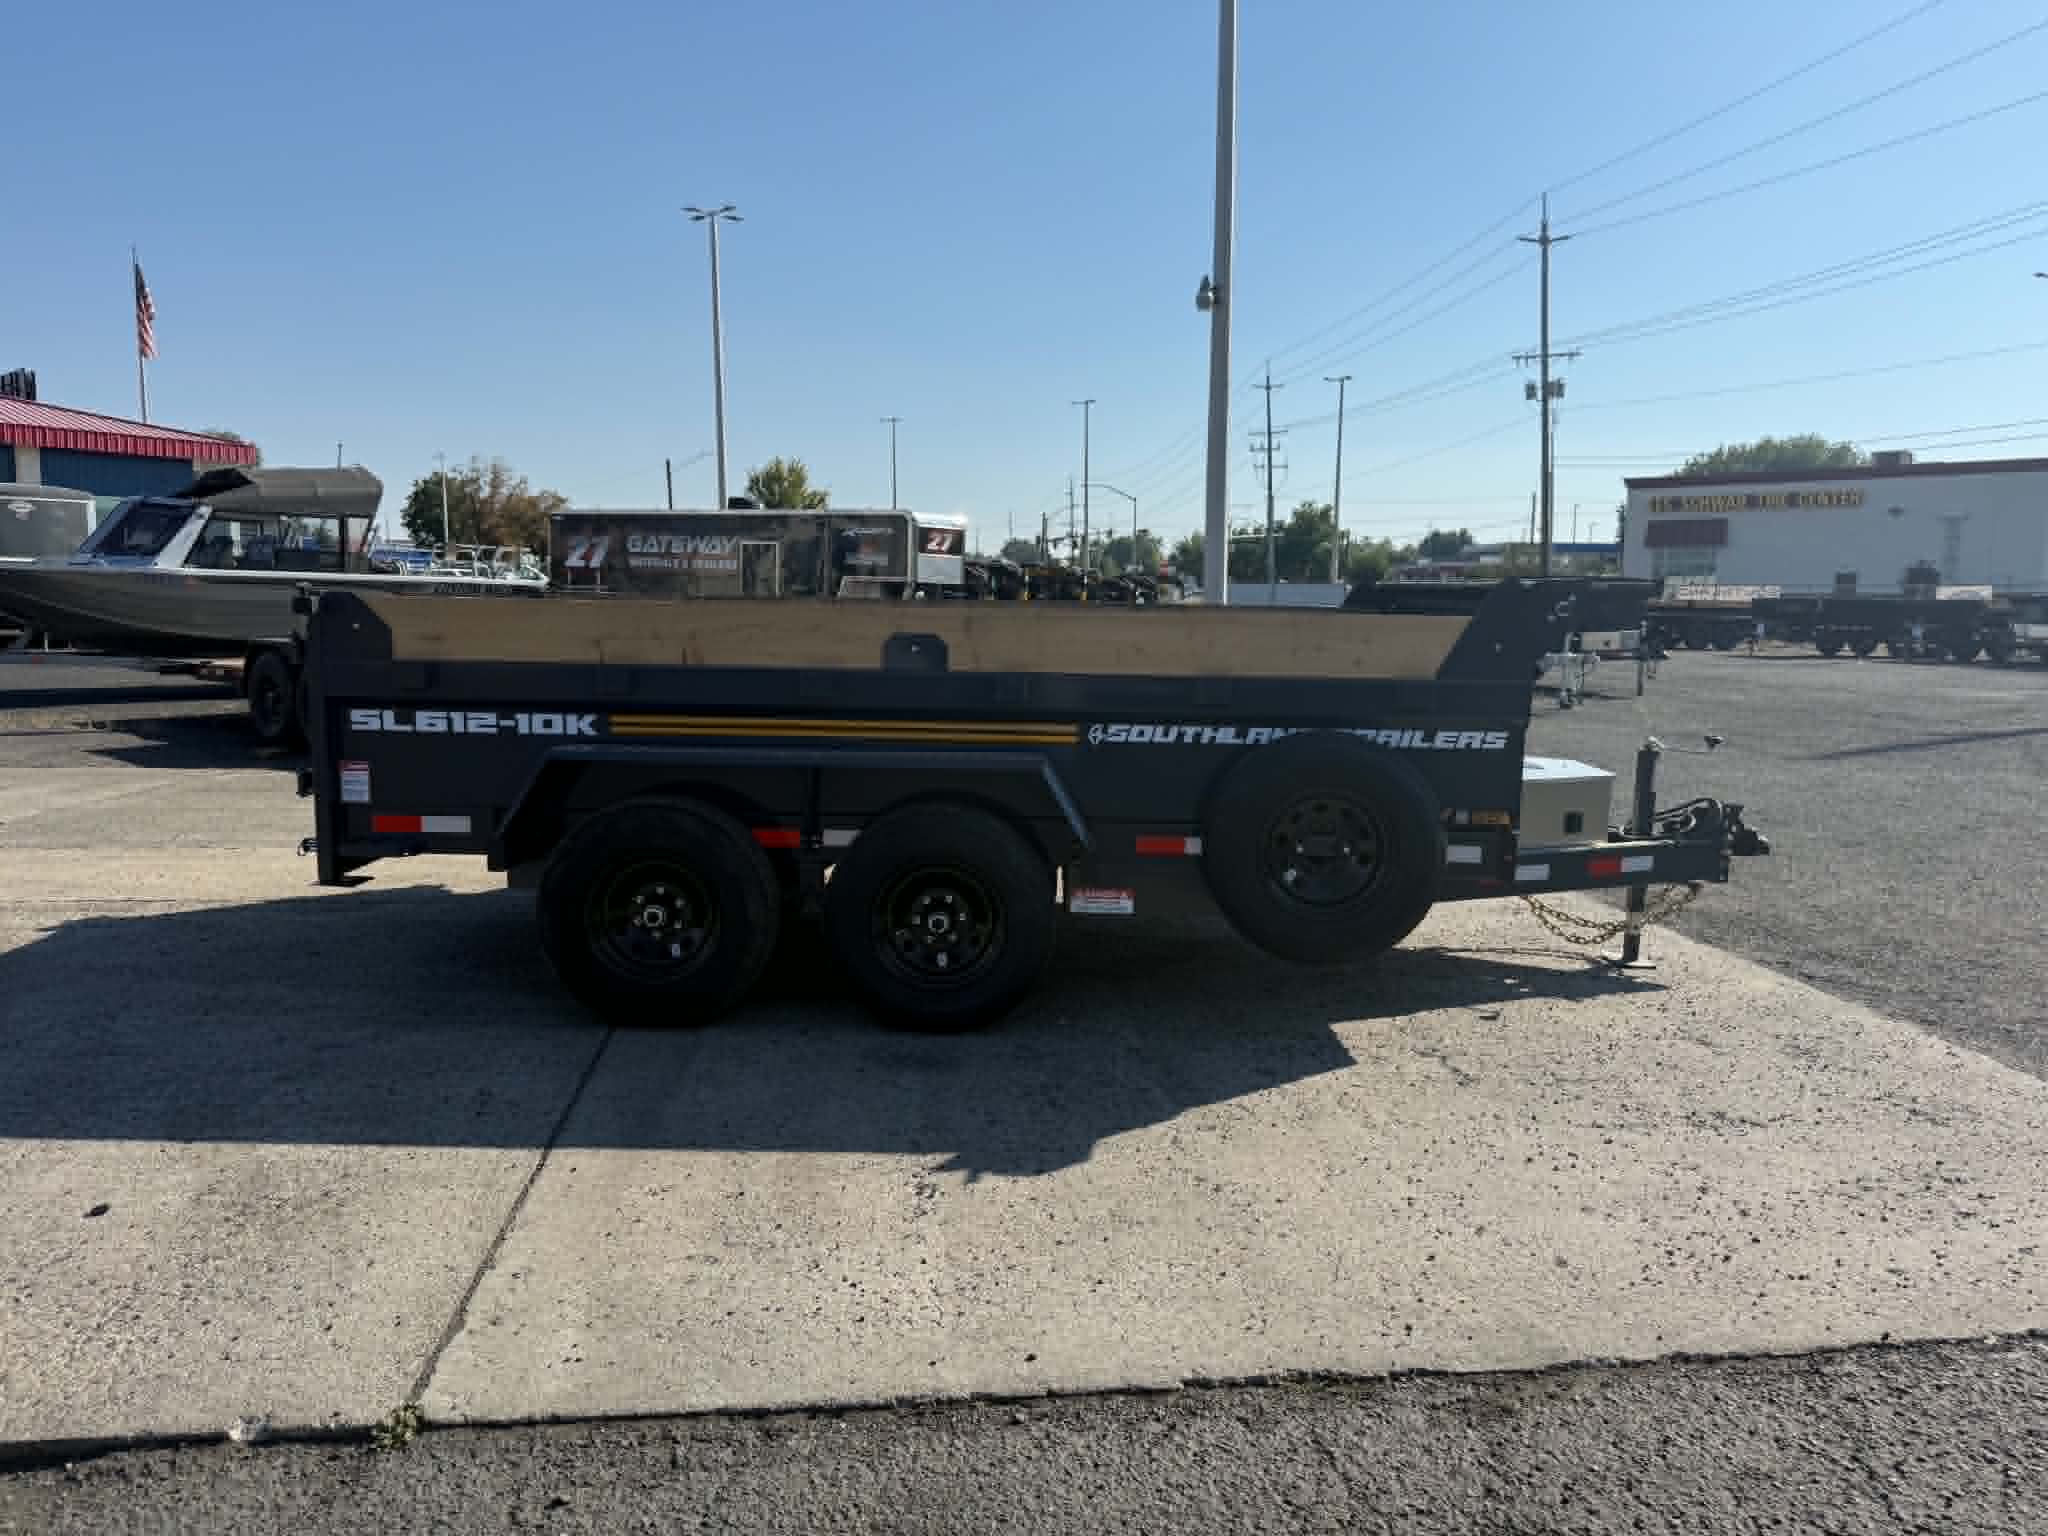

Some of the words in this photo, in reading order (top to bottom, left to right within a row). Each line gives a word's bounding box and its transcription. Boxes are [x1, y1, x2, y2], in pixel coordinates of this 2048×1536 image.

[624, 535, 737, 553] GATEWAY
[350, 708, 598, 735] SL612-10K
[1106, 724, 1316, 744] SOUTHLA
[1335, 727, 1510, 749] AILERS
